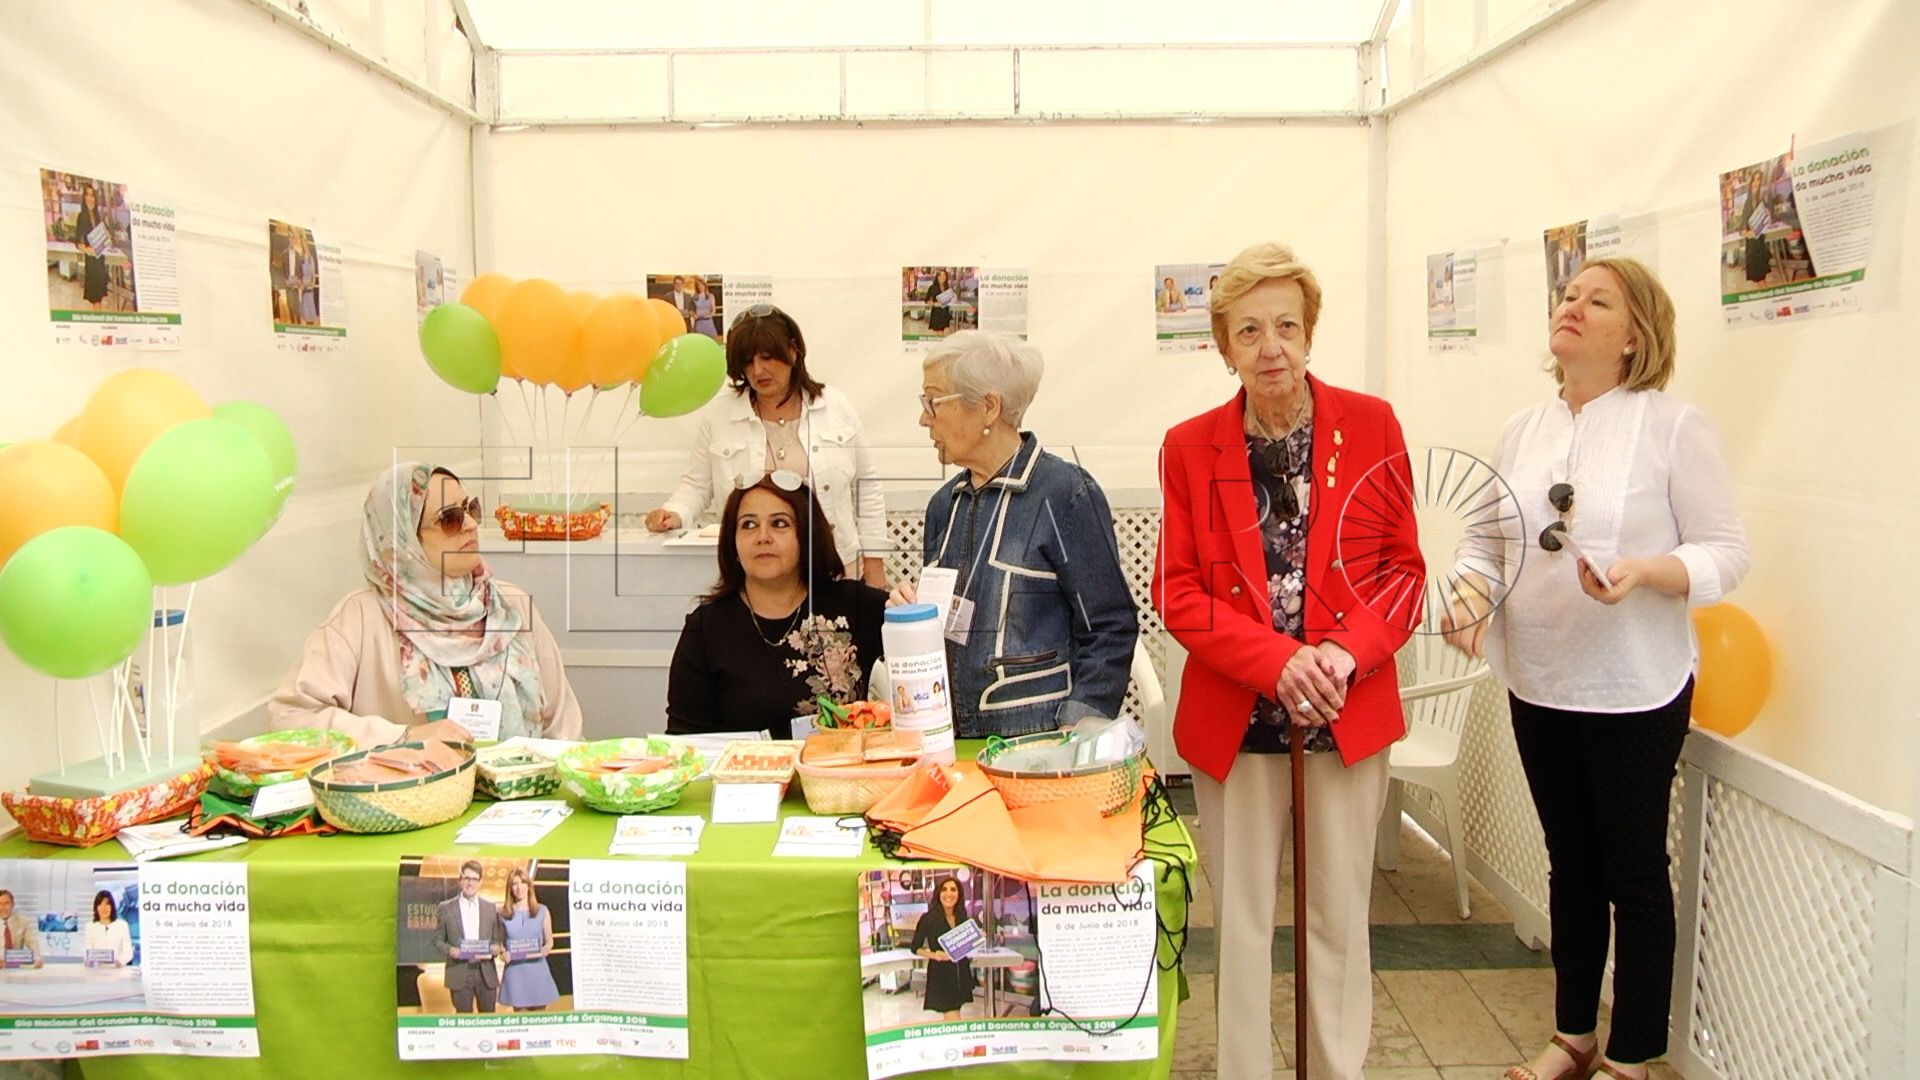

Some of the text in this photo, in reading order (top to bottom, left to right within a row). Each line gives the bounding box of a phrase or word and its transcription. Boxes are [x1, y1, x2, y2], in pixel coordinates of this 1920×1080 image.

[1792, 148, 1869, 177] La donación
[1795, 163, 1872, 192] da mucha vida
[142, 880, 245, 895] La donación
[573, 879, 683, 895] La donación
[1041, 881, 1152, 898] La donación
[142, 900, 245, 912] da mucha vida
[407, 903, 438, 916] ESTUD
[573, 899, 683, 912] da mucha vida
[1041, 899, 1153, 915] da mucha vida
[163, 920, 173, 928] de
[198, 920, 208, 928] de
[212, 920, 232, 928] 2018
[407, 916, 438, 929] ESTAD
[586, 918, 593, 926] 6
[632, 920, 643, 928] de
[647, 920, 669, 928] 2018
[1064, 922, 1075, 930] de
[1102, 920, 1113, 929] de
[1117, 919, 1139, 928] 2018
[79, 1018, 95, 1027] del
[141, 1015, 154, 1024] de
[458, 1017, 502, 1026] Nacional
[503, 1015, 519, 1025] del
[521, 1014, 564, 1025] Donante
[565, 1013, 579, 1023] de
[581, 1012, 624, 1023] Órganos
[626, 1015, 647, 1025] 2018
[923, 1023, 968, 1036] Nacional
[970, 1021, 986, 1031] del
[987, 1020, 1031, 1031] Donante
[1032, 1020, 1046, 1030] de
[1093, 1020, 1117, 1030] 2018
[556, 1038, 577, 1048] rtve
